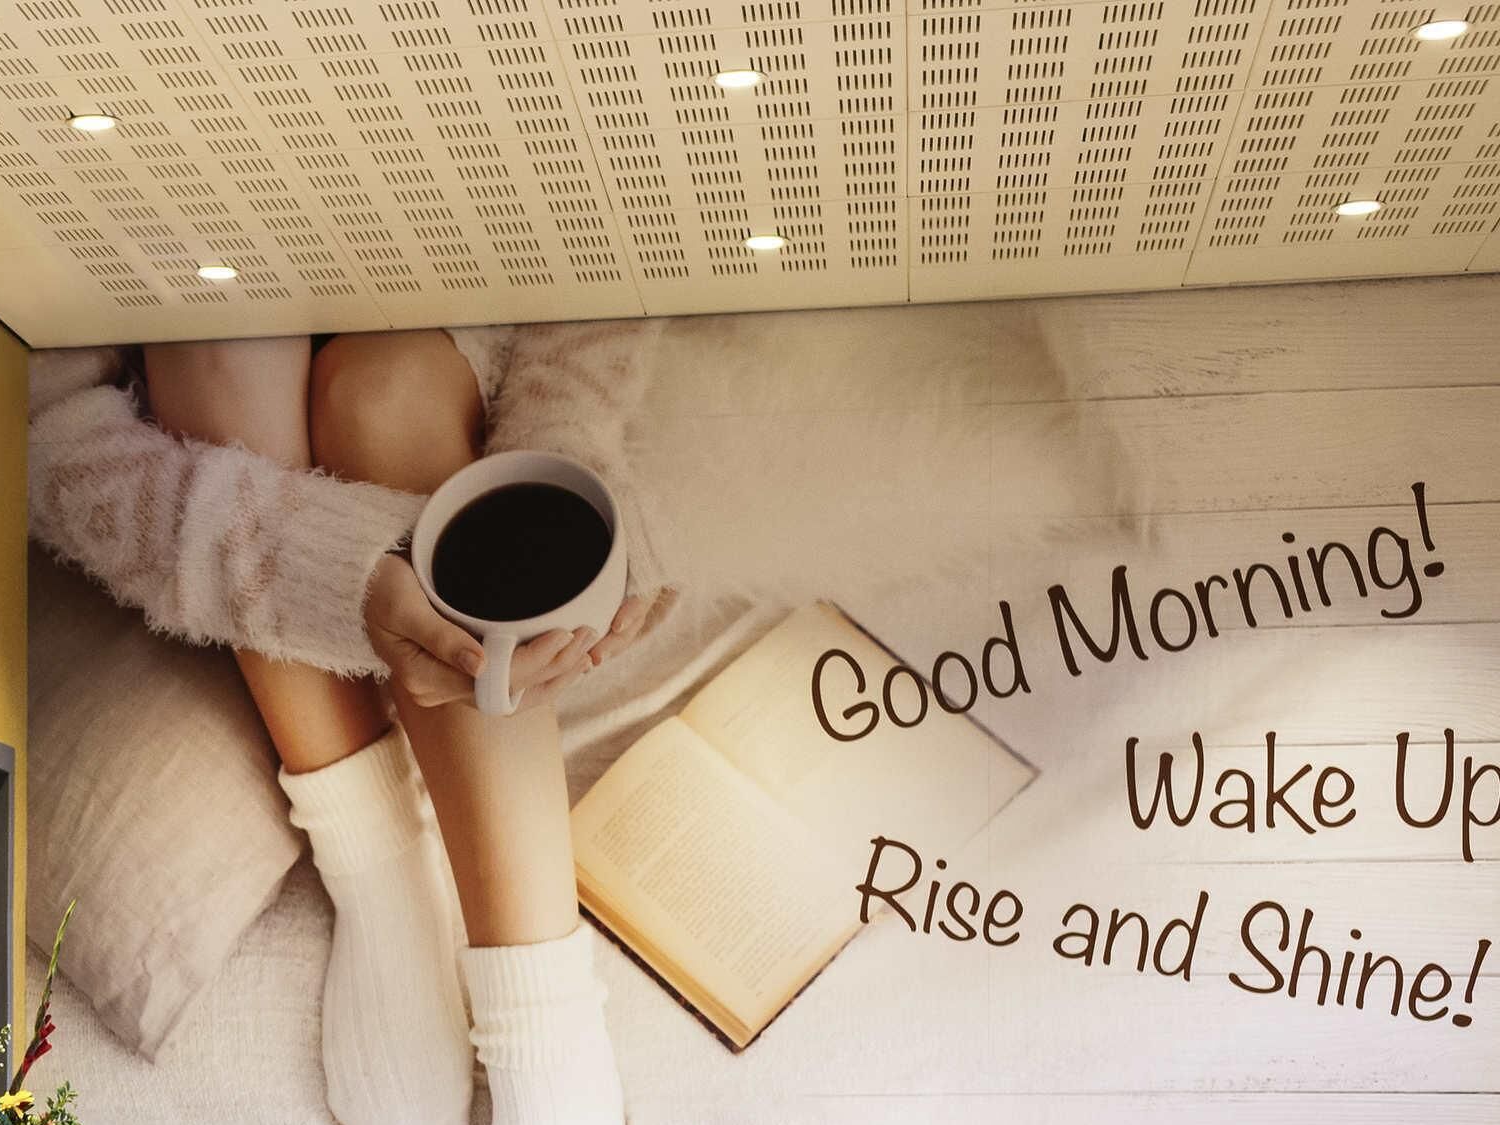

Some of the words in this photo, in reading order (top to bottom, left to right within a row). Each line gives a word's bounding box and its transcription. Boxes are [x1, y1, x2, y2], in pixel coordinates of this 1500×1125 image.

[811, 600, 1032, 742] Good
[1046, 481, 1445, 677] Morning!
[1125, 731, 1357, 834] Wake
[1395, 727, 1500, 863] Up
[855, 836, 1024, 947] Rise
[1052, 890, 1209, 982] and
[1228, 900, 1492, 1028] Shine!
